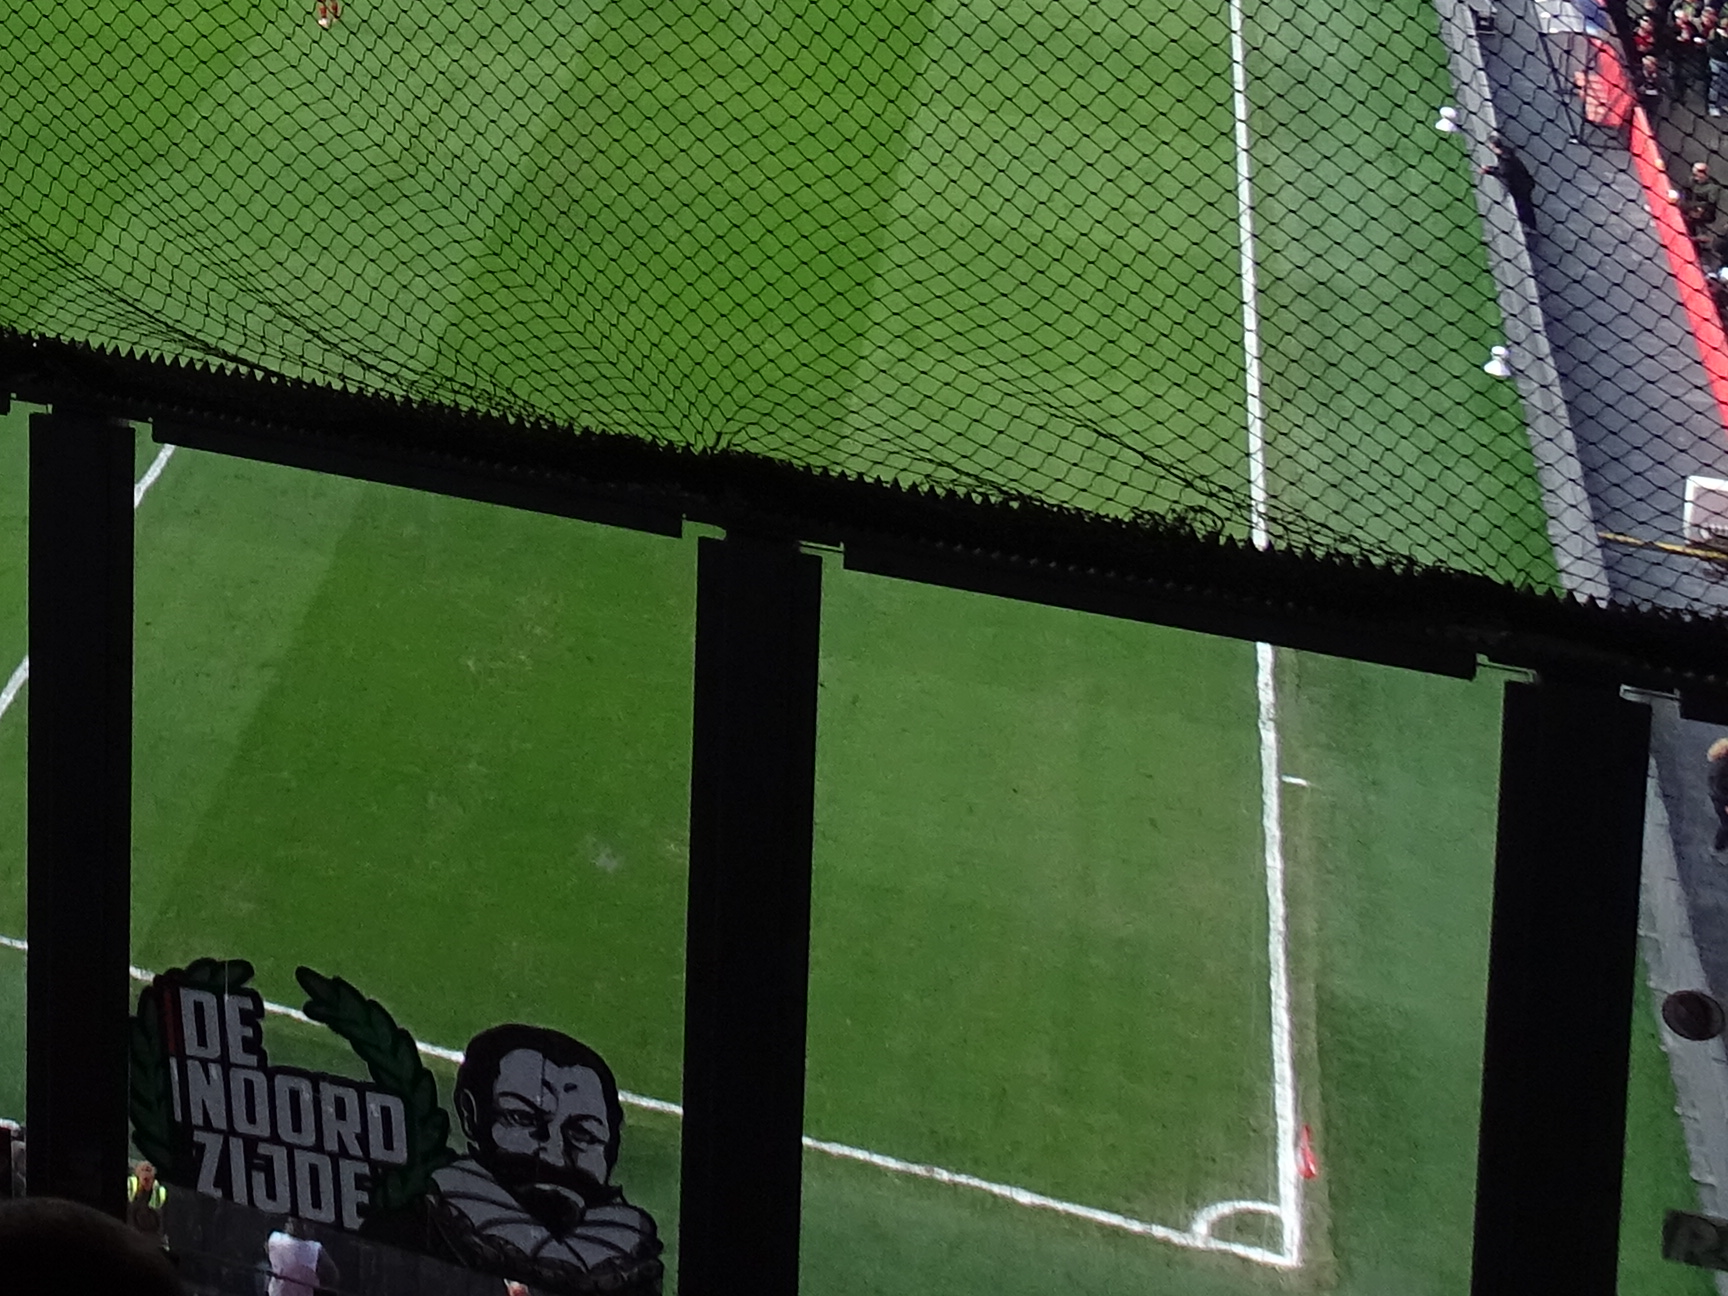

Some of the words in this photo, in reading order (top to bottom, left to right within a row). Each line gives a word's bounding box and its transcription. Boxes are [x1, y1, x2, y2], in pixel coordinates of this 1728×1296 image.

[178, 985, 259, 1068] DE
[186, 1056, 409, 1167] NOORD
[192, 1129, 374, 1232] ZIJDE
